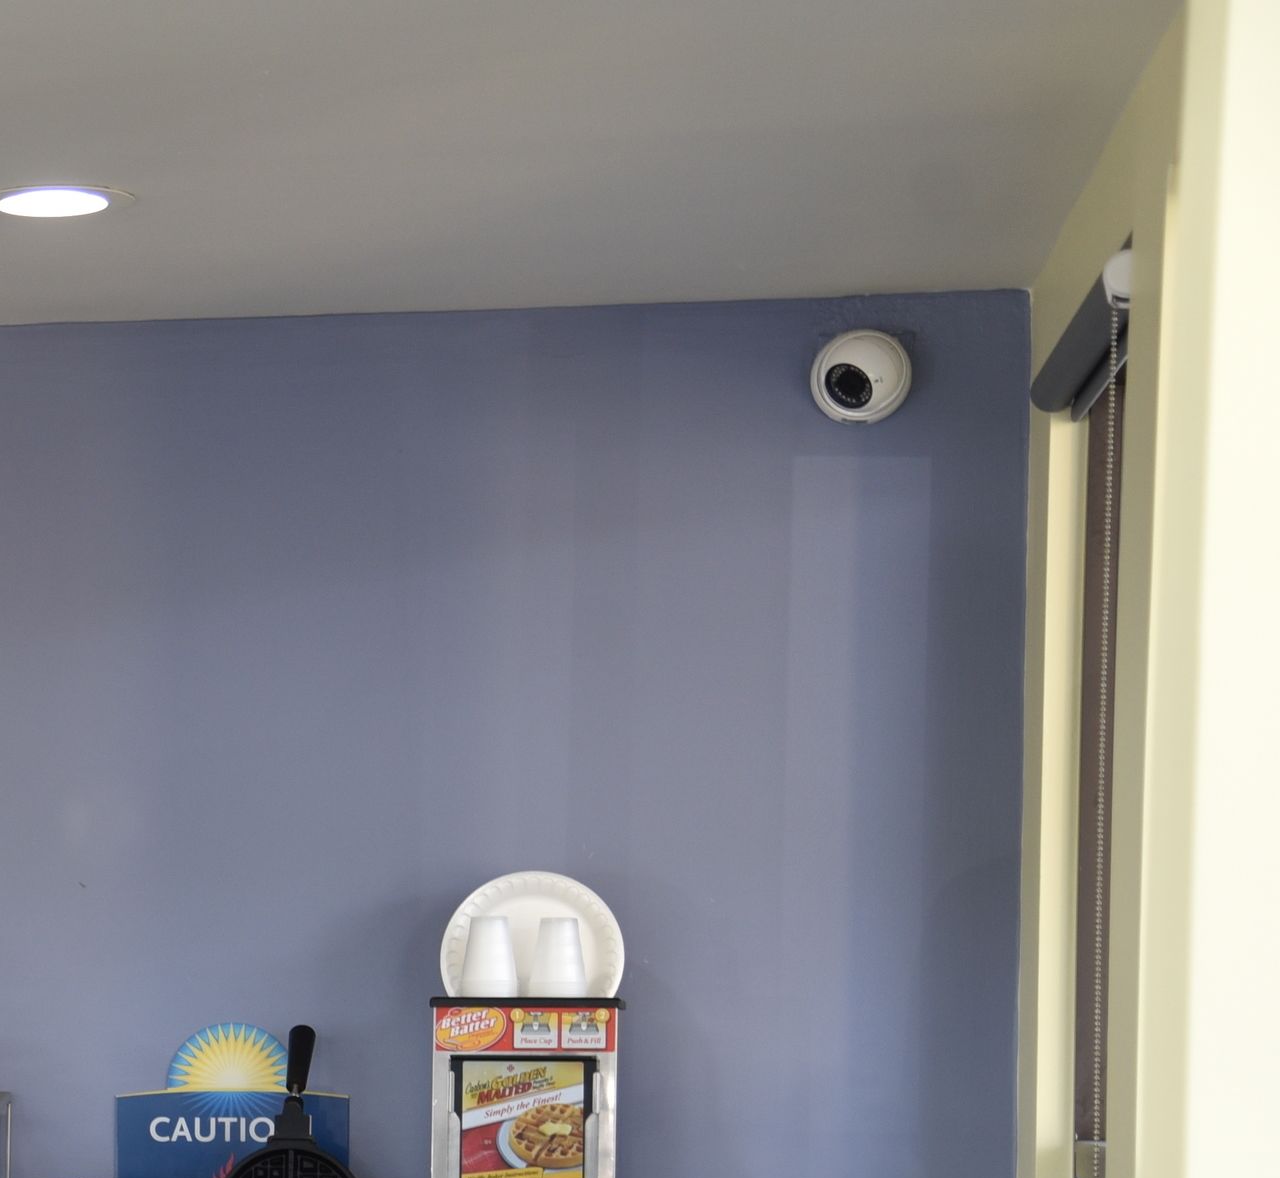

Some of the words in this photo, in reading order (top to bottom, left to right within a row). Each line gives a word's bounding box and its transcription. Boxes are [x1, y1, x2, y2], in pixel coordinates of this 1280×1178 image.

[441, 1008, 489, 1029] Better
[450, 1017, 497, 1037] Batter
[491, 1066, 547, 1089] GOLDEN
[477, 1081, 533, 1105] MALTED
[484, 1105, 514, 1119] Simply
[517, 1101, 530, 1111] the
[532, 1092, 562, 1107] Finest!
[149, 1115, 312, 1143] CAUTIO
